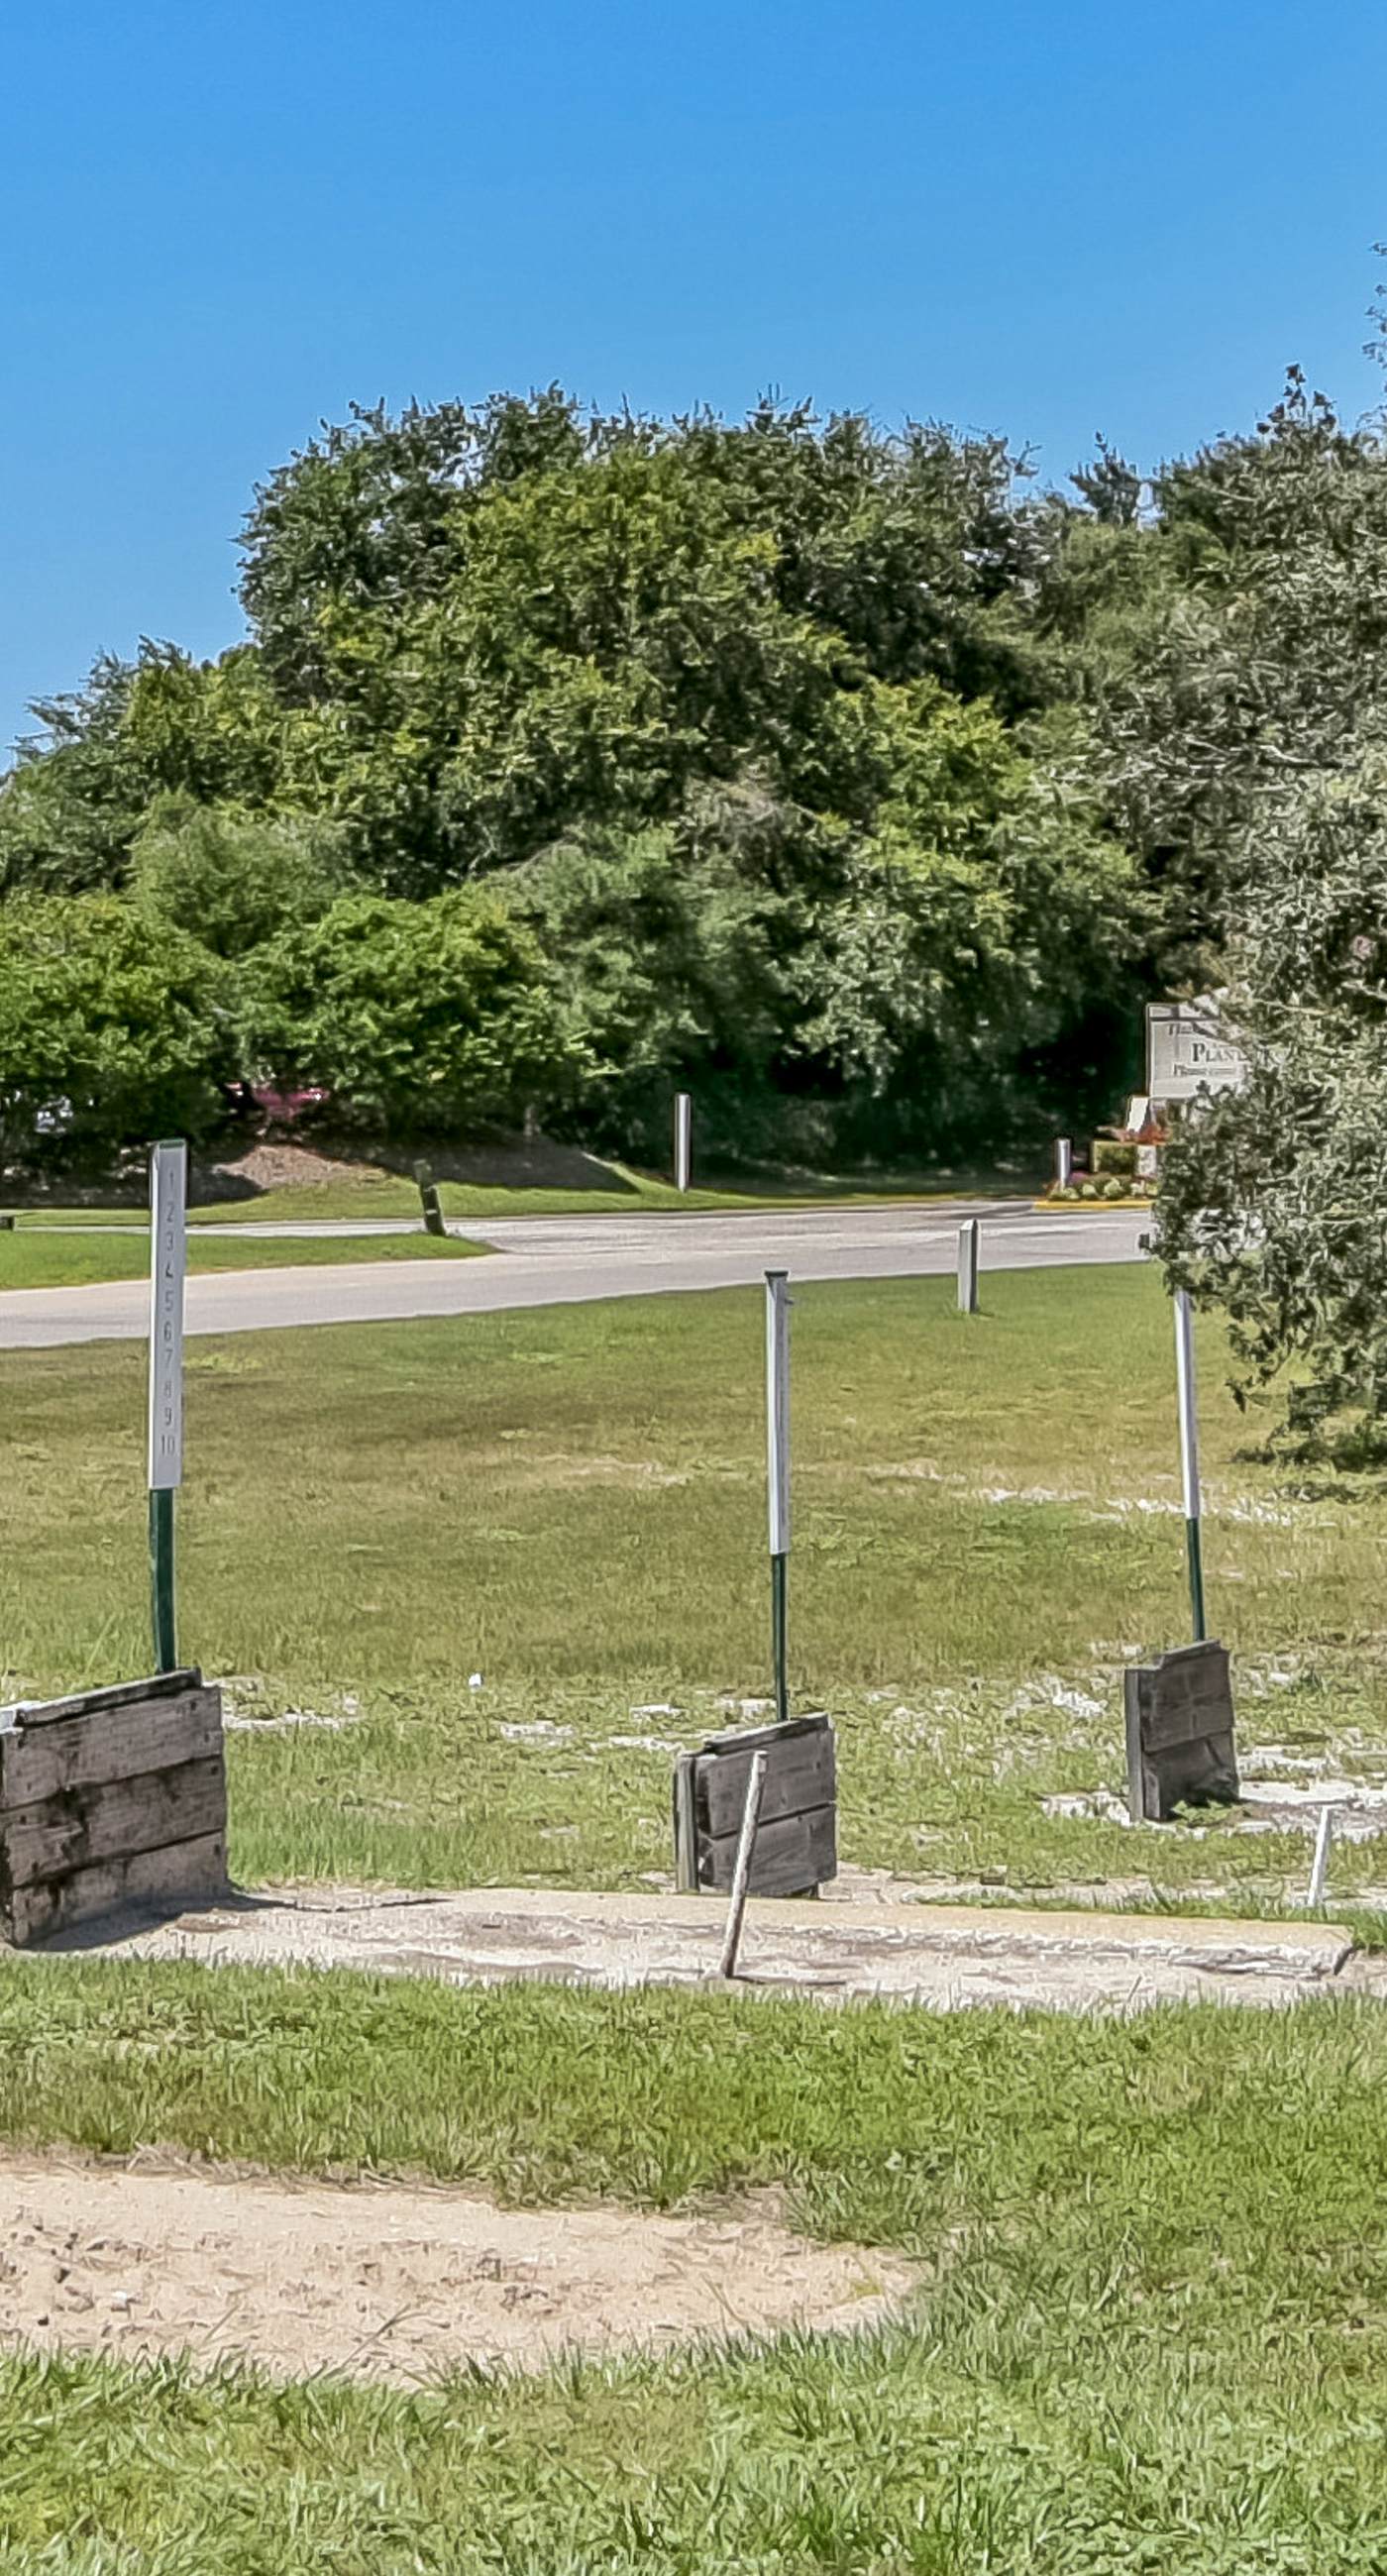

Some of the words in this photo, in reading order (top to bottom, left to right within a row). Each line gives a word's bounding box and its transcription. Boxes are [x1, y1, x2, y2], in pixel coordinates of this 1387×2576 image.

[165, 1200, 175, 1224] 2
[165, 1231, 174, 1251] 3
[164, 1260, 174, 1278] 4
[164, 1290, 174, 1312] 5
[163, 1320, 172, 1342] 6
[165, 1348, 174, 1369] 7
[163, 1380, 172, 1398] 8
[163, 1407, 172, 1427] 9
[160, 1434, 176, 1456] 10
